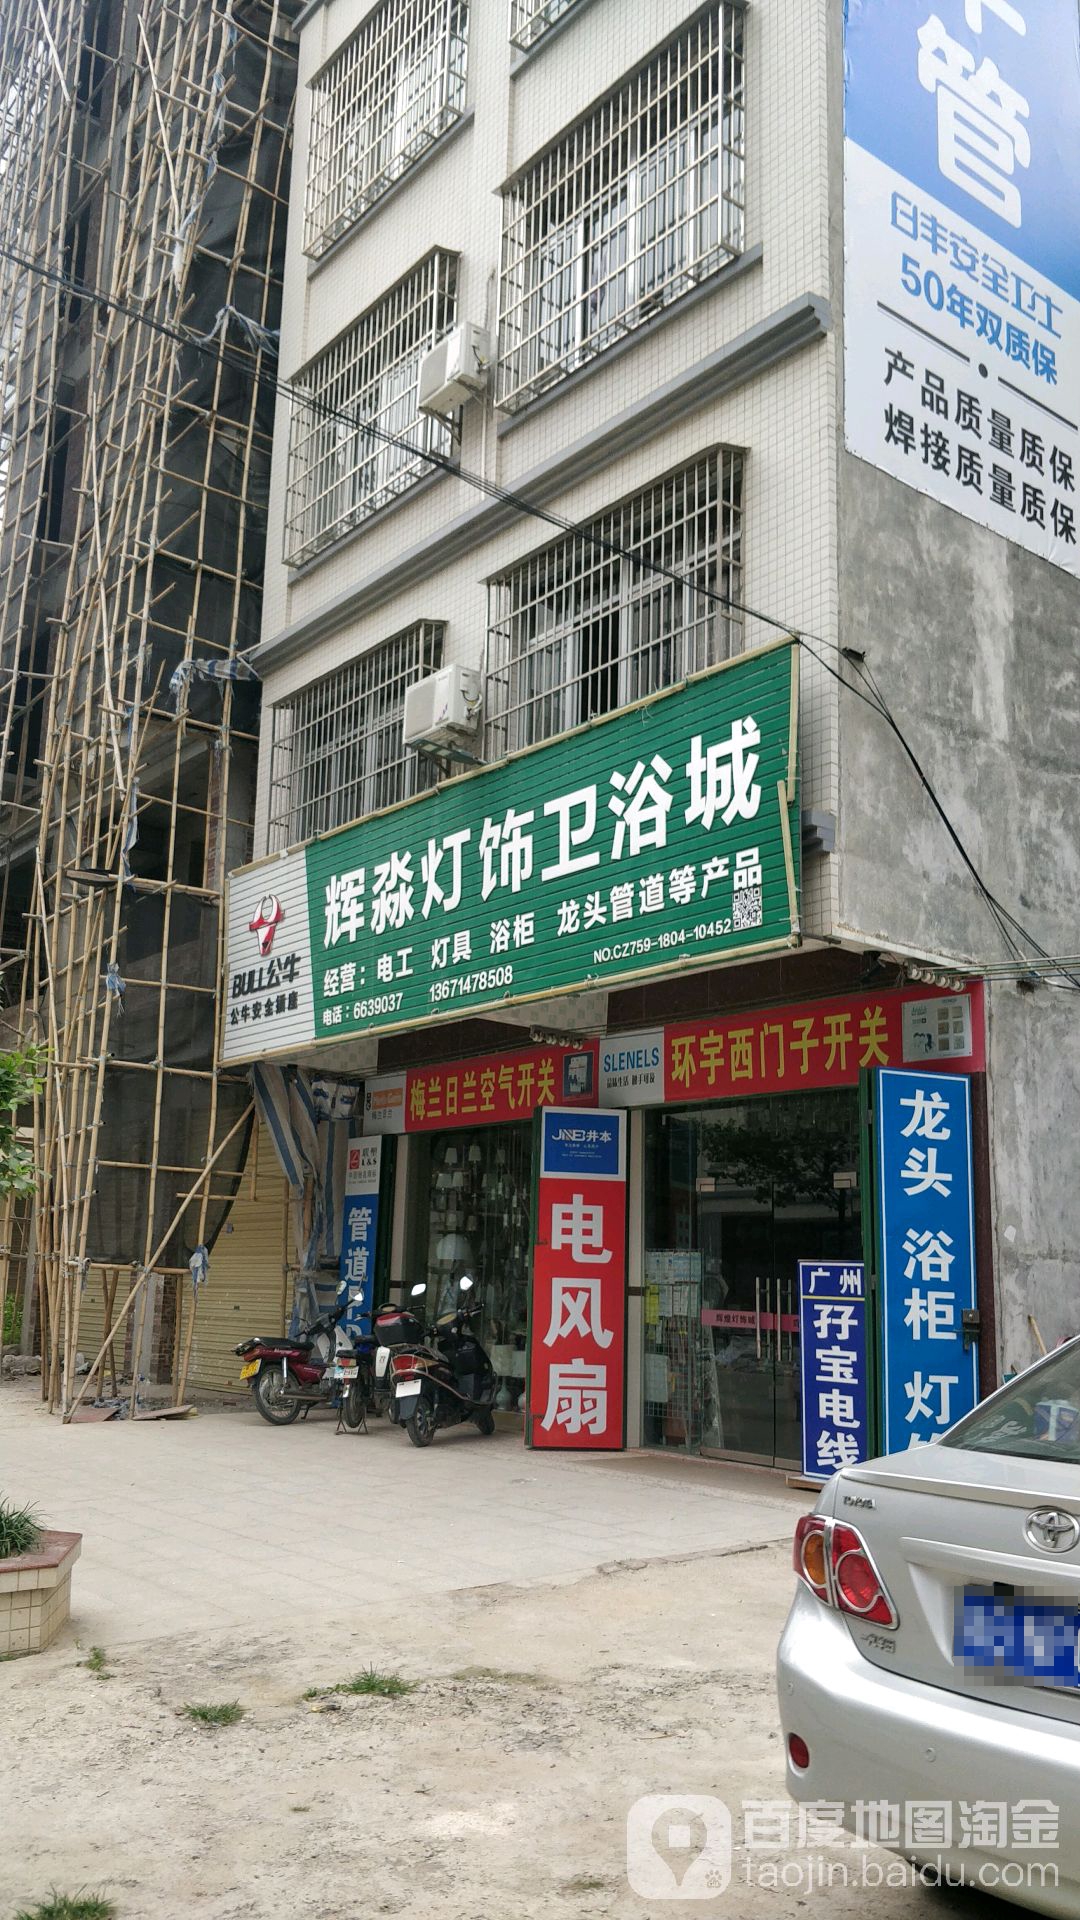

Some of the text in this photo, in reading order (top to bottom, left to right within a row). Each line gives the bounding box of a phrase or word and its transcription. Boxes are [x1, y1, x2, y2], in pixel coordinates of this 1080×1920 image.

[891, 191, 1063, 339] 日丰安全卫士
[901, 252, 1058, 386] 50年双质保
[884, 347, 1076, 492] 产品质量质保
[884, 402, 1077, 545] 焊接质量质保
[323, 715, 762, 950] 辉淼灯饰卫浴城
[431, 929, 472, 970] 灯具
[489, 912, 535, 955] 浴柜
[557, 846, 763, 937] 龙头管道等产品
[230, 990, 299, 1027] 公牛安全插座
[429, 965, 513, 1003] 13671478508
[670, 1004, 890, 1088] 环宇西门子开关
[409, 1057, 555, 1122] 梅兰日兰空气开关
[603, 1046, 660, 1073] SLENELS
[540, 1193, 615, 1435] 电风扇
[808, 1267, 863, 1297] 广州
